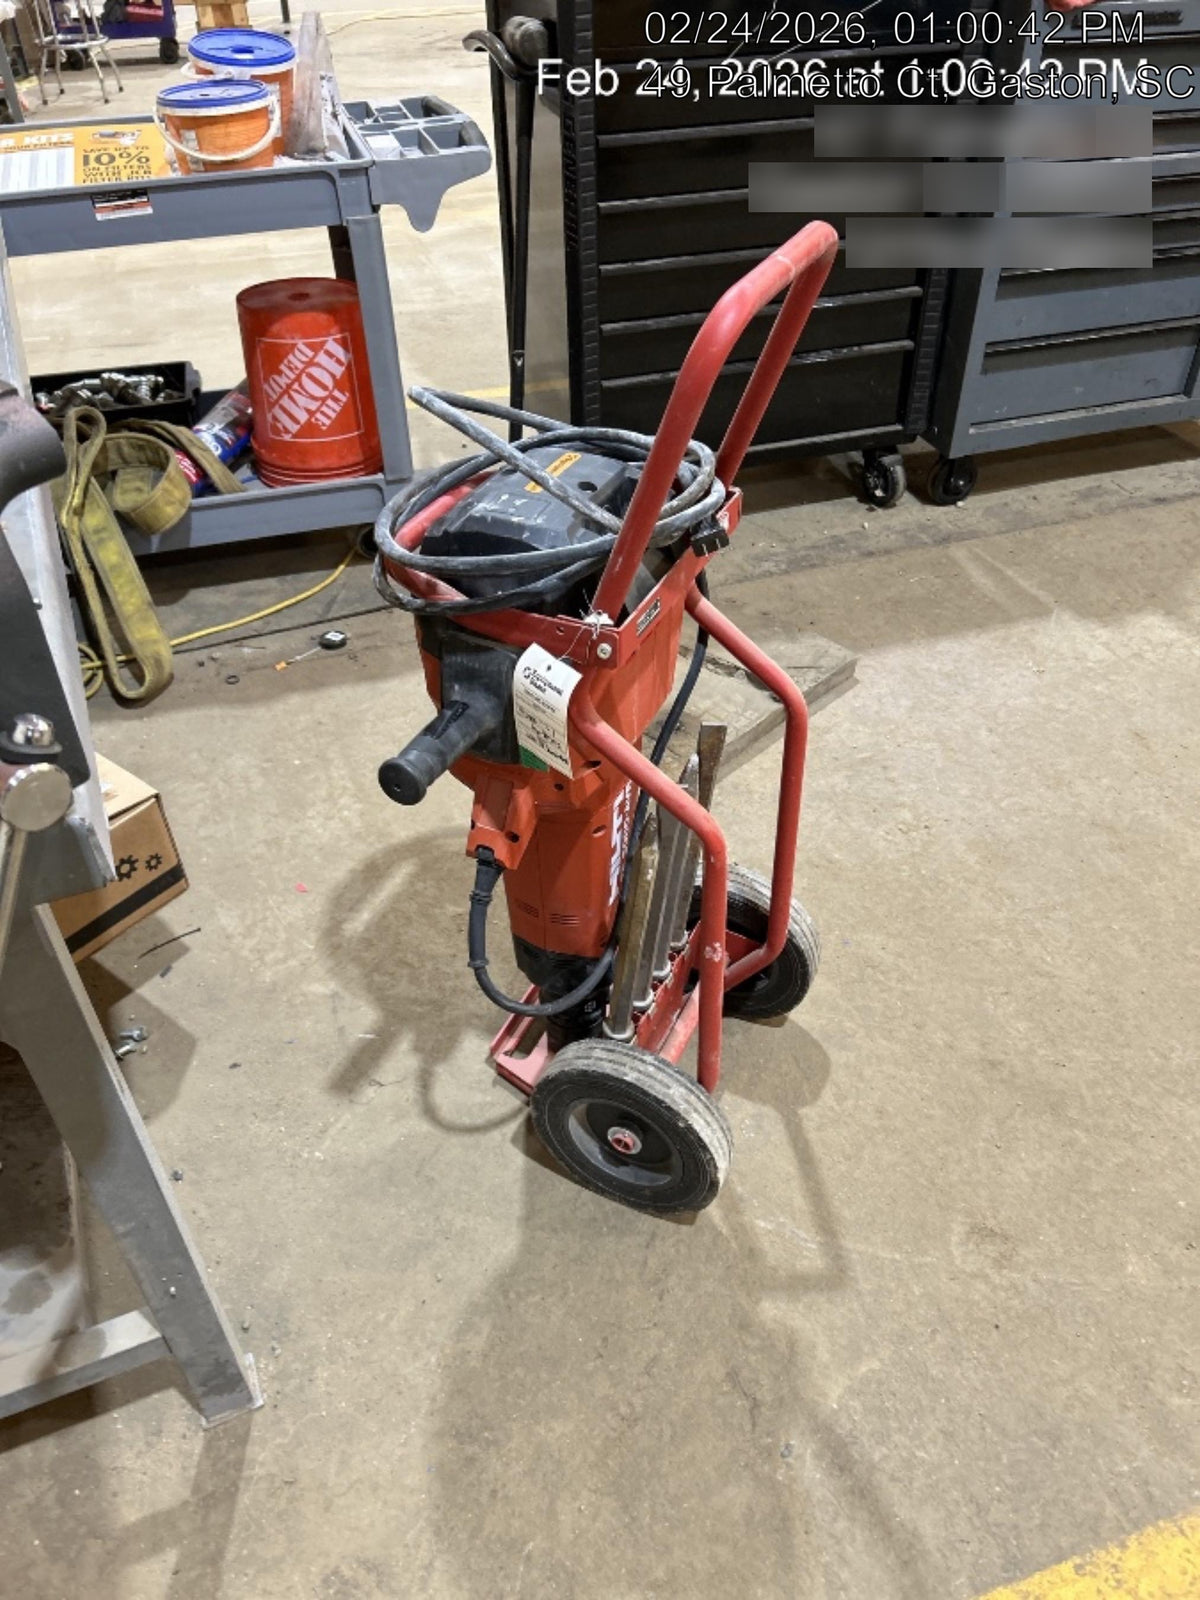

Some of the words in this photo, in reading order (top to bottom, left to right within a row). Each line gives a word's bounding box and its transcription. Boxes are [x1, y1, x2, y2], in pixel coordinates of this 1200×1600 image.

[82, 150, 150, 168] 10%
[263, 340, 316, 402] DEPOT
[268, 337, 351, 440] HOME
[310, 387, 350, 431] THE
